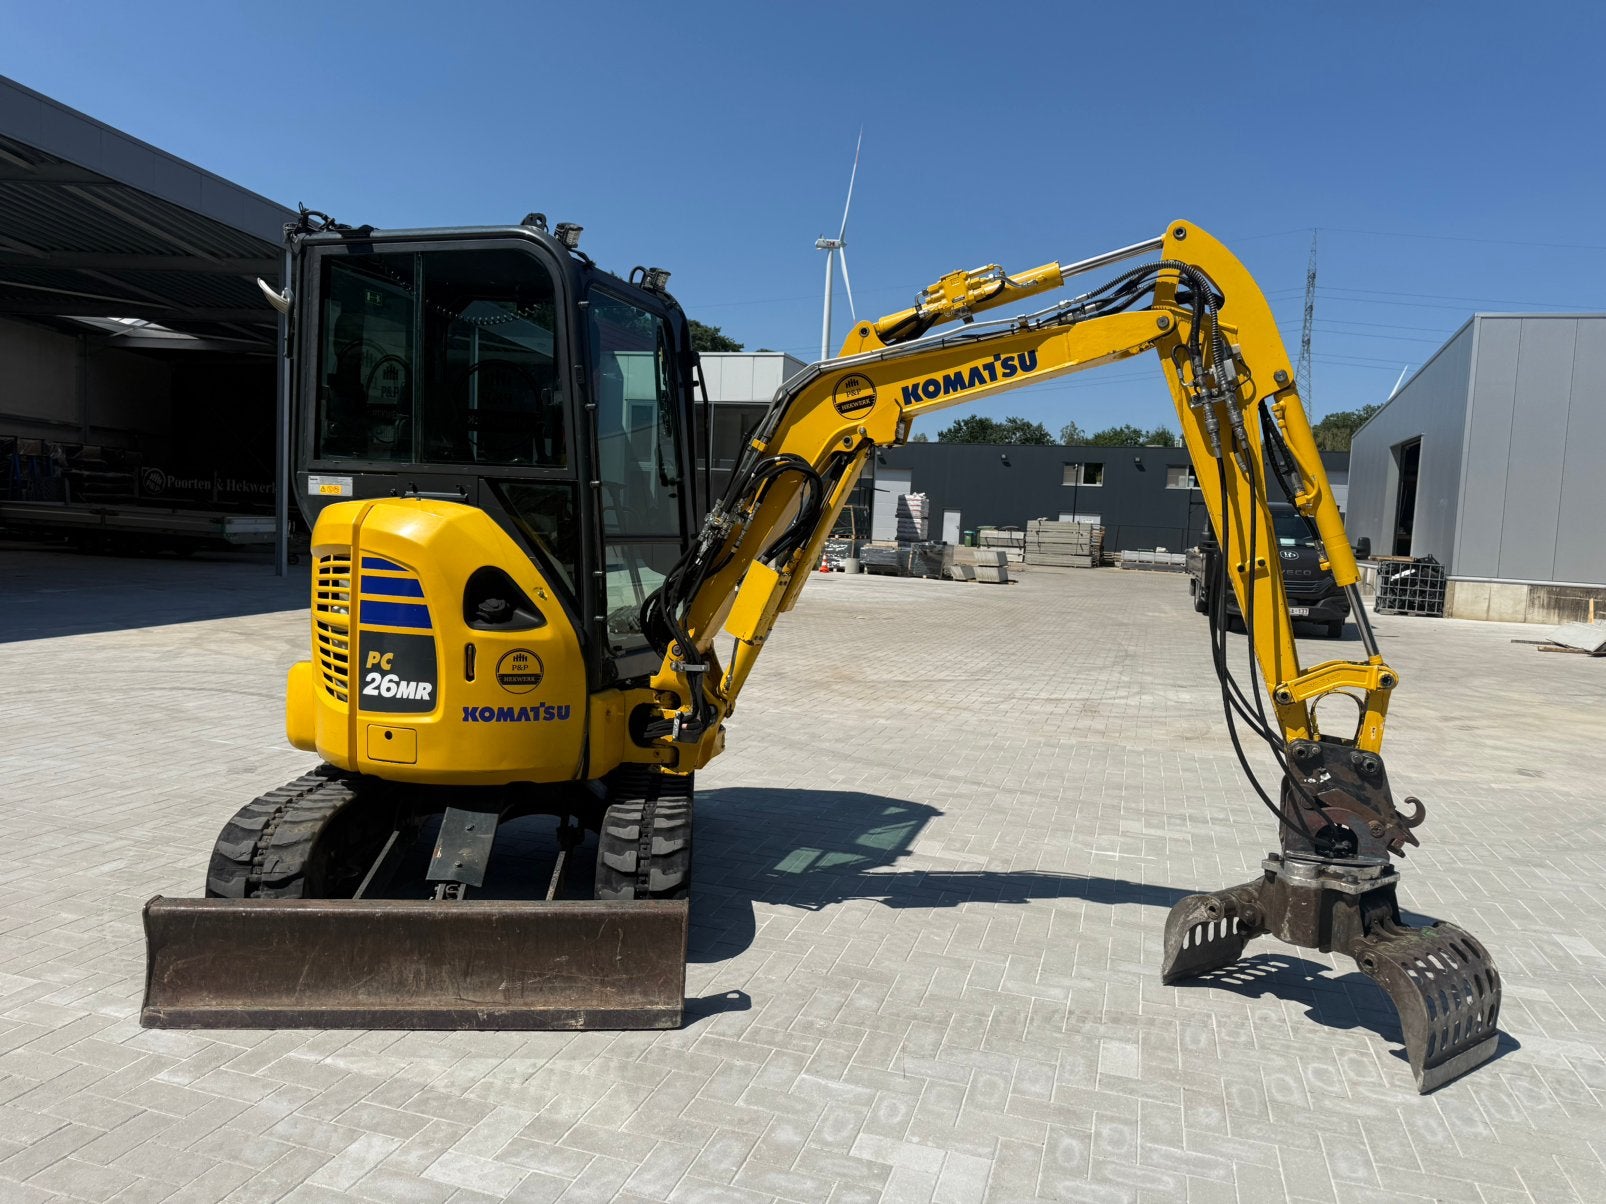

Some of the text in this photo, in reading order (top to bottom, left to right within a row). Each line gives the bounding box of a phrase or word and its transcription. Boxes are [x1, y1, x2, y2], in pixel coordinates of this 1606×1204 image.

[901, 349, 1038, 405] KOMATSU
[846, 388, 862, 398] P&P
[167, 475, 212, 491] Poorten
[365, 650, 394, 670] PC
[362, 672, 433, 701] 26MR
[462, 702, 570, 723] KOMATSU
